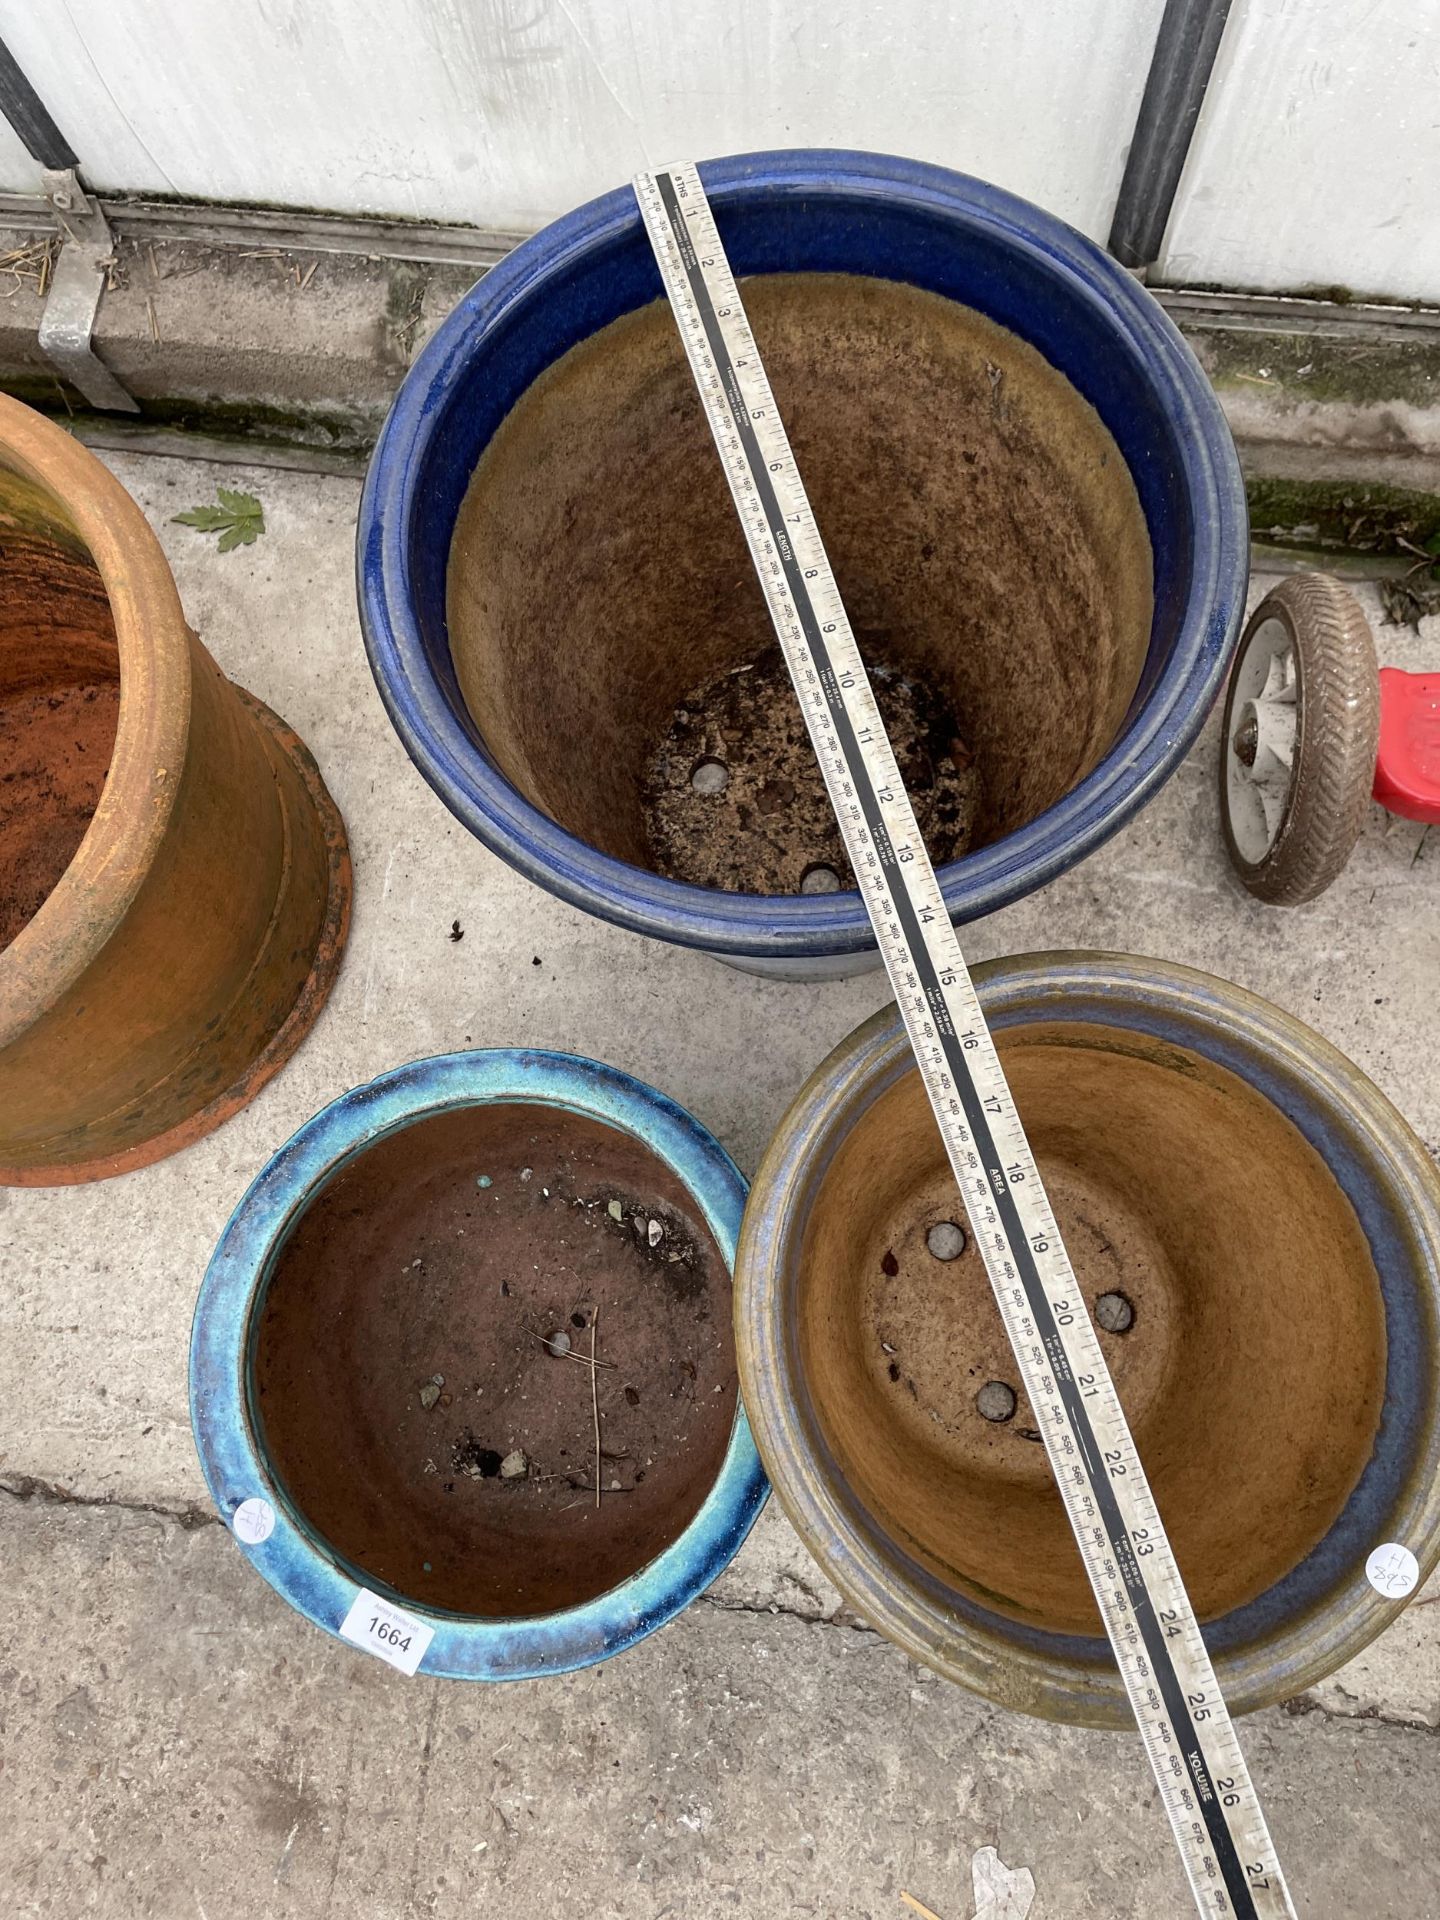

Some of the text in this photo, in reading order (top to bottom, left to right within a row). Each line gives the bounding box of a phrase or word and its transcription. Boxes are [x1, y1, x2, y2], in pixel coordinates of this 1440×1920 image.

[775, 530, 791, 561] LENGTH
[702, 258, 714, 267] 2
[718, 308, 730, 317] 3
[734, 358, 747, 368] 4
[752, 409, 765, 419] 5
[769, 462, 782, 472] 6
[786, 515, 800, 525] 7
[804, 568, 818, 579] 8
[822, 623, 836, 633] 9
[838, 670, 855, 689] 10
[857, 726, 873, 744] 11
[877, 785, 893, 804] 12
[897, 844, 914, 863] 13
[918, 904, 935, 924] 14
[938, 966, 956, 986] 15
[960, 1029, 978, 1050] 16
[983, 1094, 1001, 1116] 17
[1006, 1162, 1024, 1184] 18
[1030, 1231, 1049, 1254] 19
[1053, 1299, 1074, 1327] 20
[1078, 1373, 1099, 1398] 21
[1104, 1448, 1127, 1477] 22
[1131, 1527, 1154, 1557] 23
[1159, 1608, 1182, 1638] 24
[1187, 1691, 1211, 1722] 25
[1217, 1775, 1240, 1807] 26
[1246, 1861, 1269, 1893] 27
[702, 355, 711, 368] 100
[708, 375, 718, 388] 110
[715, 395, 725, 408] 120
[722, 415, 732, 429] 130
[729, 436, 738, 449] 140
[735, 456, 745, 470] 150
[742, 477, 752, 490] 160
[749, 497, 759, 511] 170
[756, 518, 766, 532] 180
[762, 540, 772, 554] 190
[769, 561, 779, 575] 200
[776, 582, 786, 596] 210
[783, 603, 793, 618] 220
[791, 625, 801, 640] 230
[798, 647, 808, 661] 240
[805, 669, 815, 683] 250
[813, 691, 823, 706] 260
[819, 713, 830, 728] 270
[827, 736, 837, 751] 280
[834, 758, 845, 774] 290
[842, 781, 853, 796] 300
[850, 804, 860, 820] 310
[857, 827, 868, 843] 320
[865, 851, 876, 867] 330
[873, 874, 884, 890] 340
[881, 898, 892, 915] 350
[889, 922, 900, 939] 360
[897, 947, 908, 963] 370
[905, 971, 916, 988] 380
[914, 996, 925, 1012] 390
[922, 1021, 933, 1038] 400
[930, 1046, 942, 1063] 410
[939, 1072, 950, 1089] 420
[948, 1097, 959, 1115] 430
[957, 1124, 968, 1141] 440
[966, 1151, 977, 1168] 450
[975, 1177, 986, 1195] 460
[984, 1205, 995, 1223] 470
[993, 1232, 1005, 1251] 480
[1002, 1260, 1014, 1279] 490
[1012, 1288, 1024, 1307] 500
[1021, 1317, 1033, 1336] 510
[1031, 1346, 1043, 1365] 520
[1041, 1375, 1053, 1395] 530
[1051, 1405, 1063, 1424] 540
[1061, 1434, 1074, 1454] 550
[1071, 1465, 1084, 1485] 560
[1082, 1496, 1094, 1516] 570
[1092, 1527, 1105, 1547] 580
[1103, 1559, 1115, 1579] 590
[1113, 1590, 1127, 1611] 600
[1124, 1622, 1137, 1644] 610
[1135, 1655, 1148, 1677] 620
[1146, 1688, 1159, 1710] 630
[1157, 1721, 1170, 1743] 640
[1168, 1755, 1182, 1777] 650
[1180, 1788, 1193, 1810] 660
[1191, 1822, 1204, 1844] 670
[1202, 1856, 1216, 1878] 680
[1213, 1889, 1227, 1911] 690
[989, 1167, 1005, 1195] AREA
[368, 1616, 413, 1652] 1664
[1187, 1751, 1212, 1802] VOLUME
